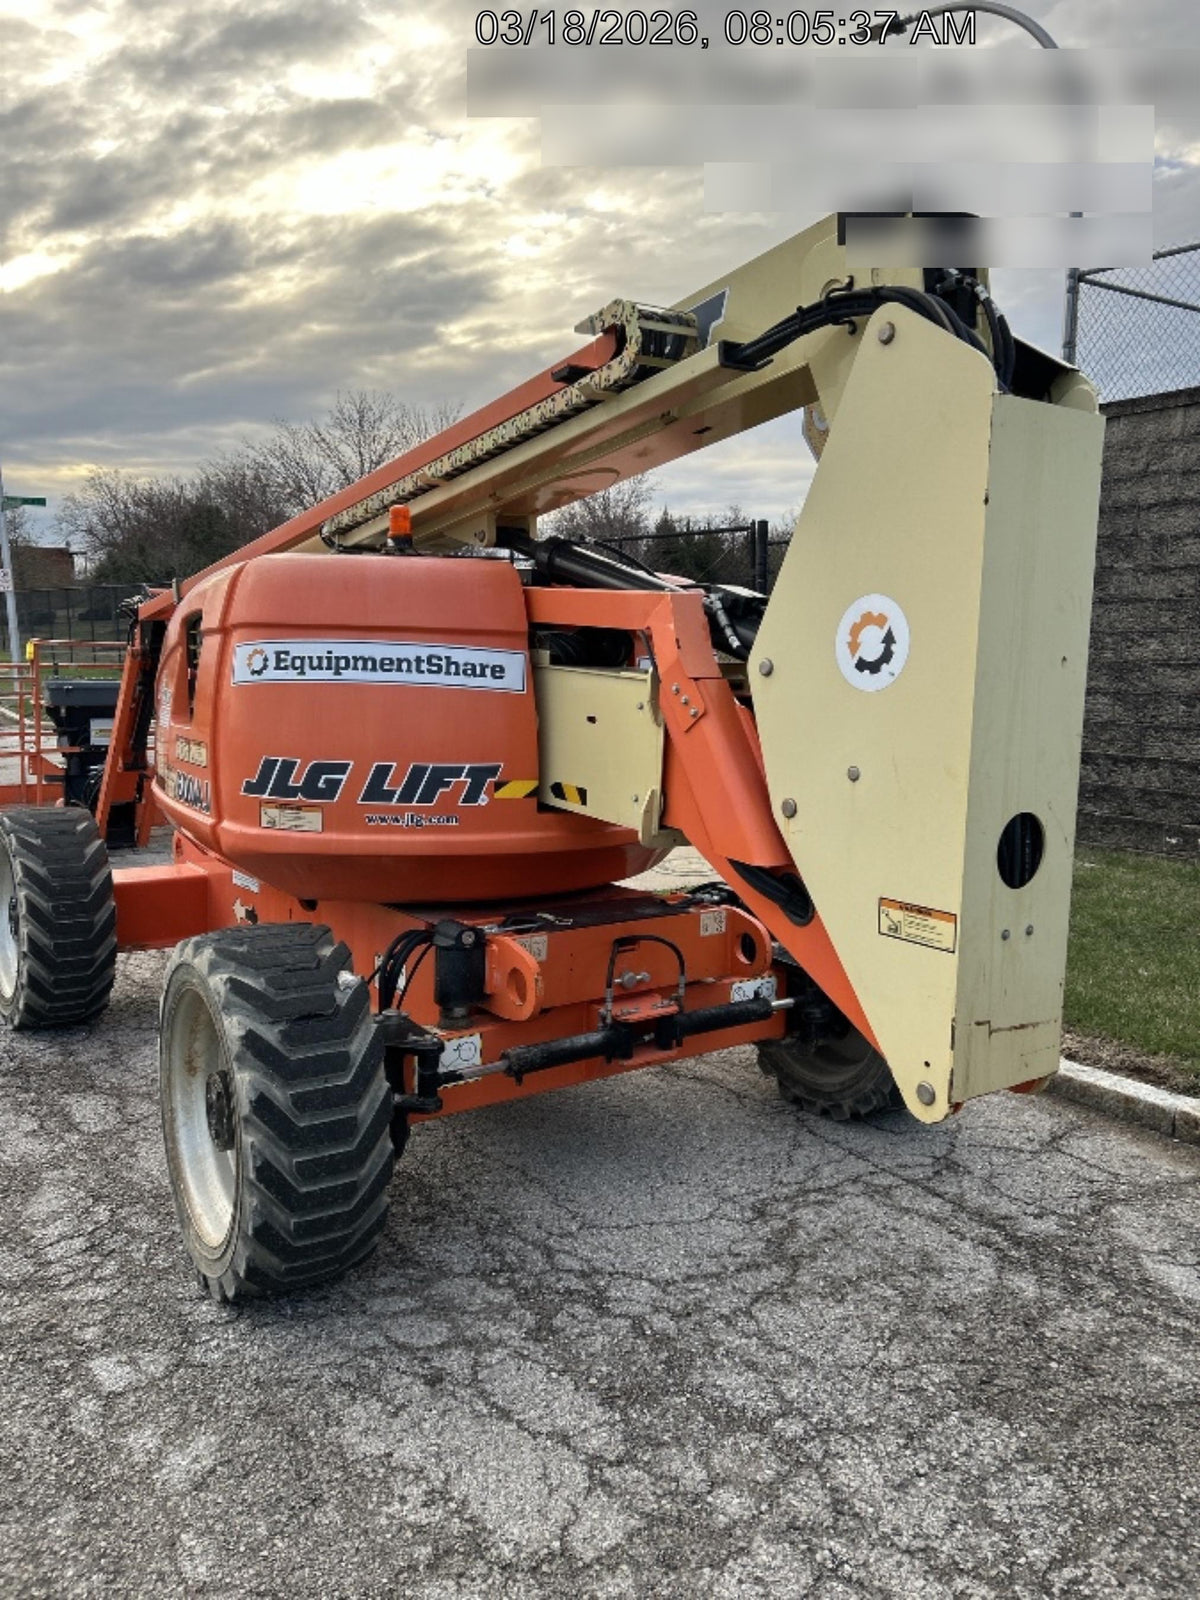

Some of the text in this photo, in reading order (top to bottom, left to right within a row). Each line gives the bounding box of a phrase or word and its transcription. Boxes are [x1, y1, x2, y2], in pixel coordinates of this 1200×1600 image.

[273, 650, 506, 680] EquipmentShare
[240, 755, 503, 806] JLG LIFT
[364, 812, 459, 828] www.jlg.com
